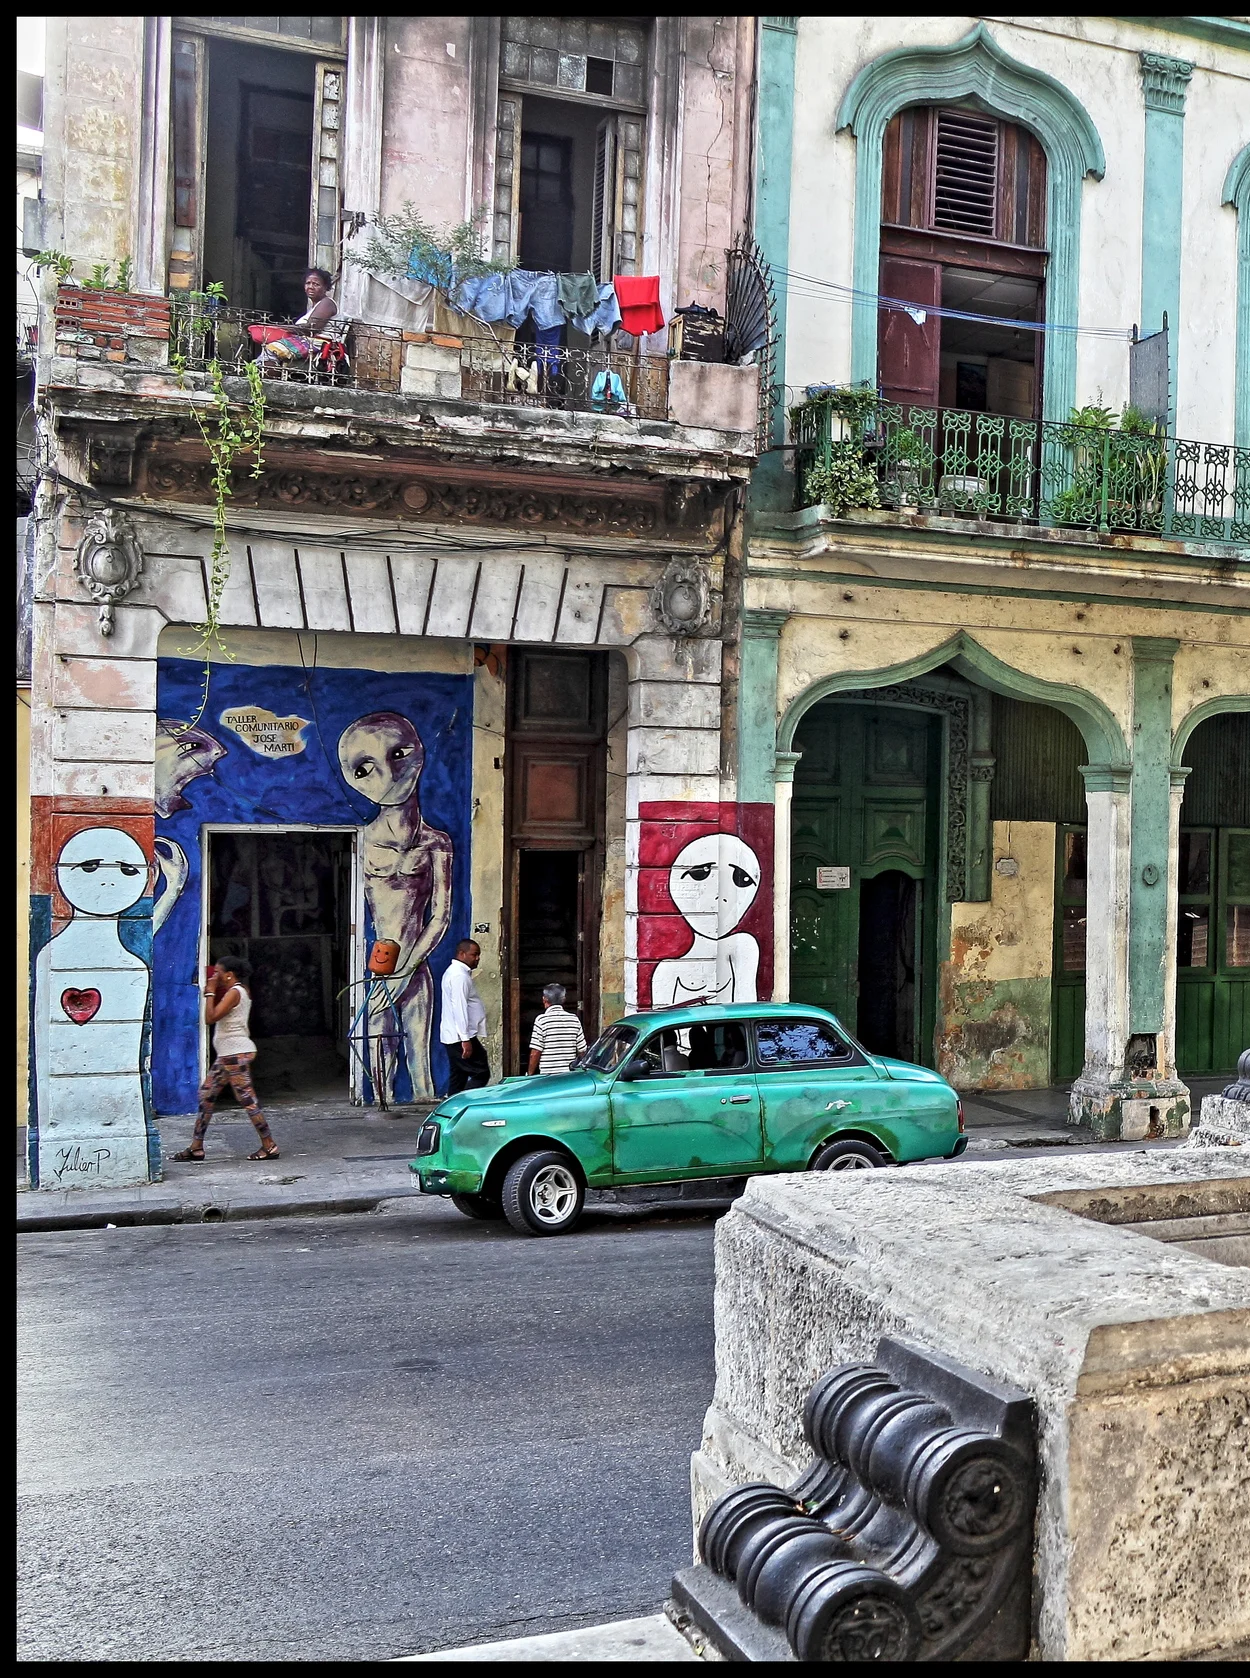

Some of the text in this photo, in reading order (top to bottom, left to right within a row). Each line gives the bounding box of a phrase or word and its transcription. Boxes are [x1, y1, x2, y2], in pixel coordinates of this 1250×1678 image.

[226, 715, 257, 723] TALLER
[235, 721, 299, 732] COMUNITARIO
[252, 733, 277, 743] JOSE
[264, 743, 295, 752] MARTI
